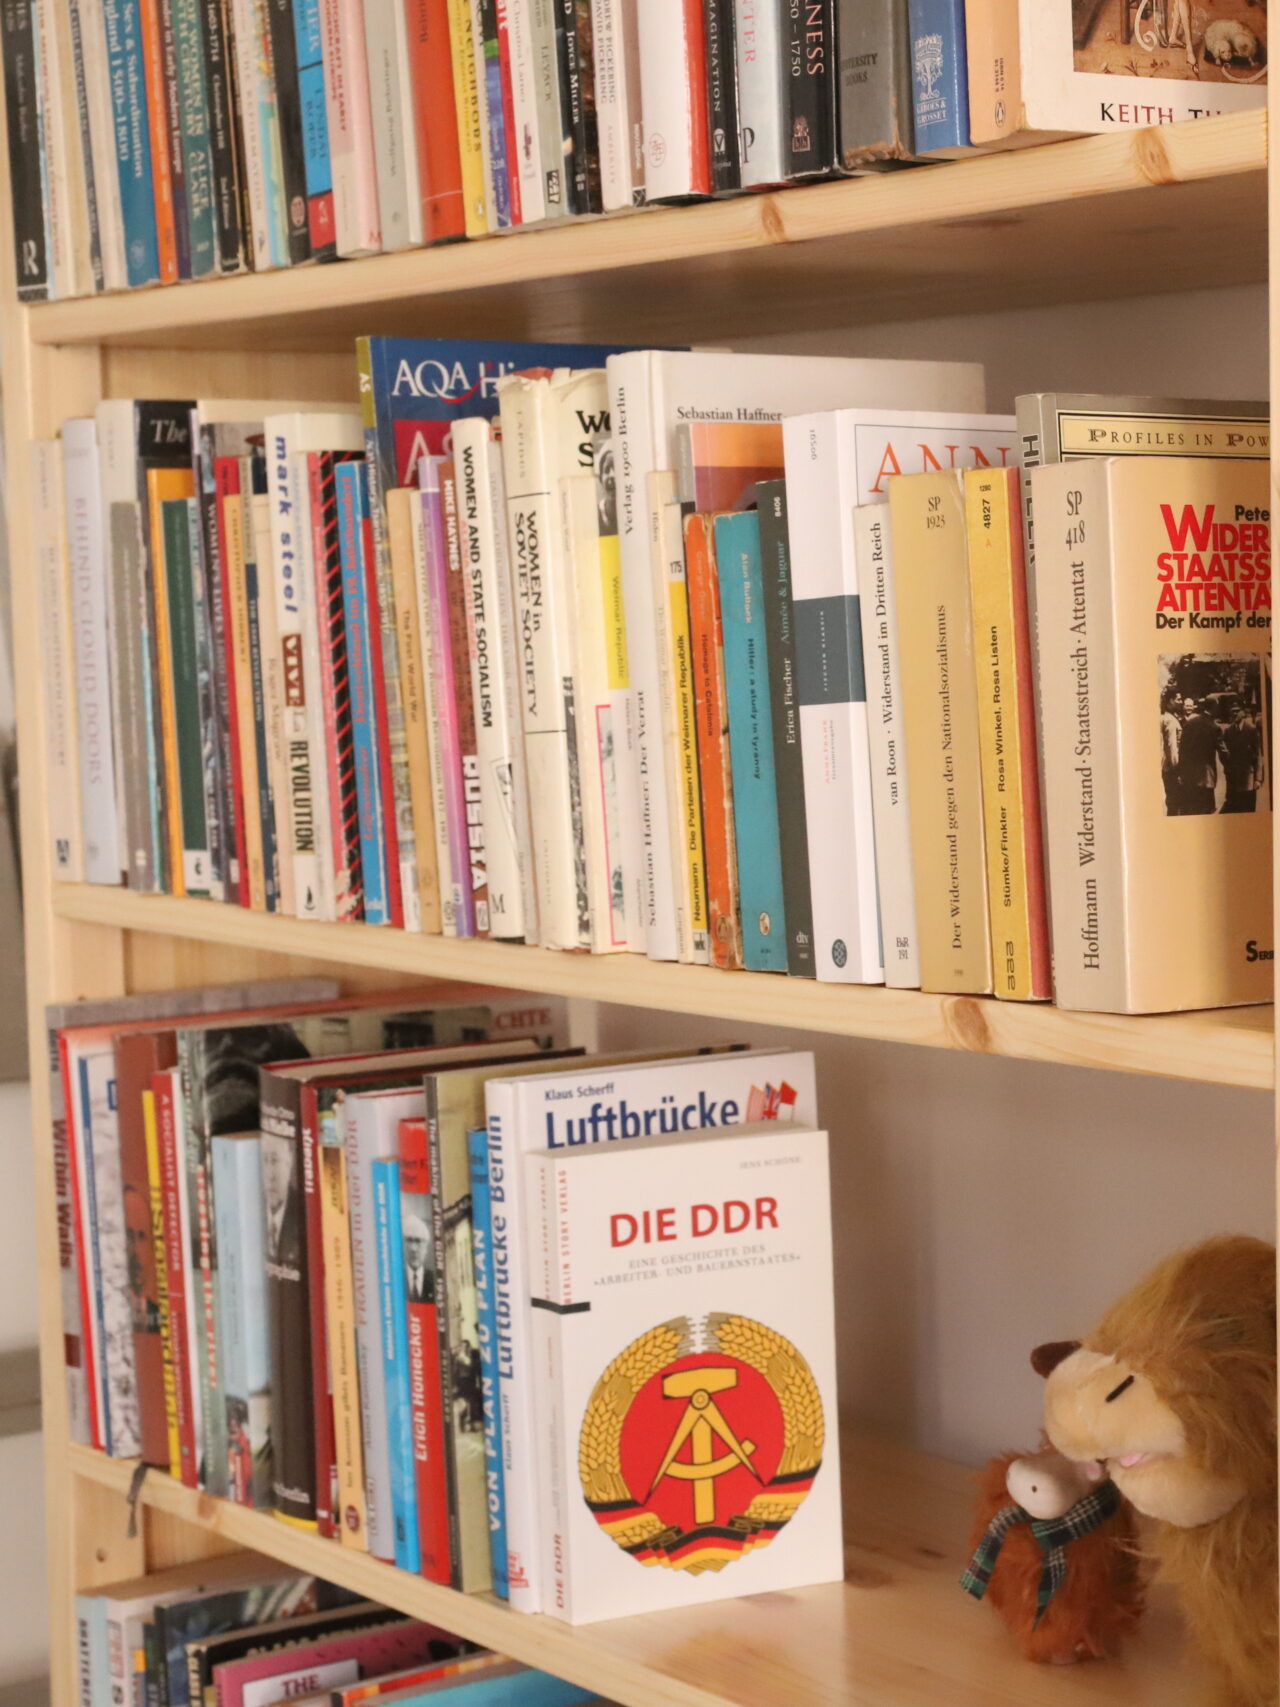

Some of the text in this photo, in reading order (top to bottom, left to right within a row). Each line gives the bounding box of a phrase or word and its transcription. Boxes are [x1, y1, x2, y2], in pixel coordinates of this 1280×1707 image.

[790, 40, 801, 76] 1750
[805, 0, 825, 75] NESS
[1100, 102, 1173, 125] KEITH
[391, 359, 472, 399] AQA
[616, 387, 628, 435] Berlin
[677, 405, 733, 422] Sebastian
[1087, 428, 1186, 447] PROFILES
[1195, 434, 1215, 447] IN
[444, 479, 456, 517] MIKE
[624, 484, 634, 535] Verlag
[928, 496, 941, 511] SP
[982, 498, 991, 529] 4827
[1065, 490, 1083, 516] SP
[447, 520, 459, 571] HAYNES
[1065, 521, 1085, 550] 418
[1160, 503, 1271, 553] WIDER
[463, 446, 492, 728] WOMEN AND STATE SOCIALISM
[524, 511, 543, 632] WOMEN in
[1156, 552, 1271, 584] STAATSS
[513, 511, 538, 717] SOVIET SOCIETY
[1156, 583, 1272, 612] ATTENTA
[274, 437, 315, 852] mark steel VIVE REVOLUTION
[1156, 611, 1271, 633] Der Kampf der
[677, 635, 690, 688] Republik
[869, 523, 898, 806] van Roon Widerstand im Dritten Reich
[989, 626, 998, 667] Listen
[780, 658, 794, 706] Fischer
[991, 670, 1001, 703] Rosa
[635, 691, 647, 739] Verrat
[681, 691, 693, 751] Weimarer
[784, 709, 797, 745] Erica
[638, 745, 649, 775] Der
[935, 605, 963, 949] Der Widerstand gegen den Nationalsozialismus
[996, 757, 1006, 793] Rosa
[1068, 561, 1101, 970] Hoffmann Widerstand Staatsstreich Attentat
[685, 776, 696, 829] Parteien
[688, 831, 698, 851] Die
[998, 806, 1012, 907] Stümke/Finkler
[643, 852, 658, 927] Sebastian
[690, 863, 702, 922] Neumann
[545, 1082, 615, 1101] Klaus Scherff
[545, 1090, 740, 1150] Luftbrücke
[558, 1169, 568, 1213] VERLAG
[560, 1221, 571, 1257] STORY
[609, 1196, 779, 1248] DIE DDR
[486, 1116, 515, 1380] Luftbrücke Berlin
[628, 1243, 766, 1270] EINE GESCHICHTE DES
[666, 1264, 693, 1277] UND
[408, 1313, 428, 1462] Erich Honecker
[472, 1229, 501, 1531] VON PLAN ZU PLAN
